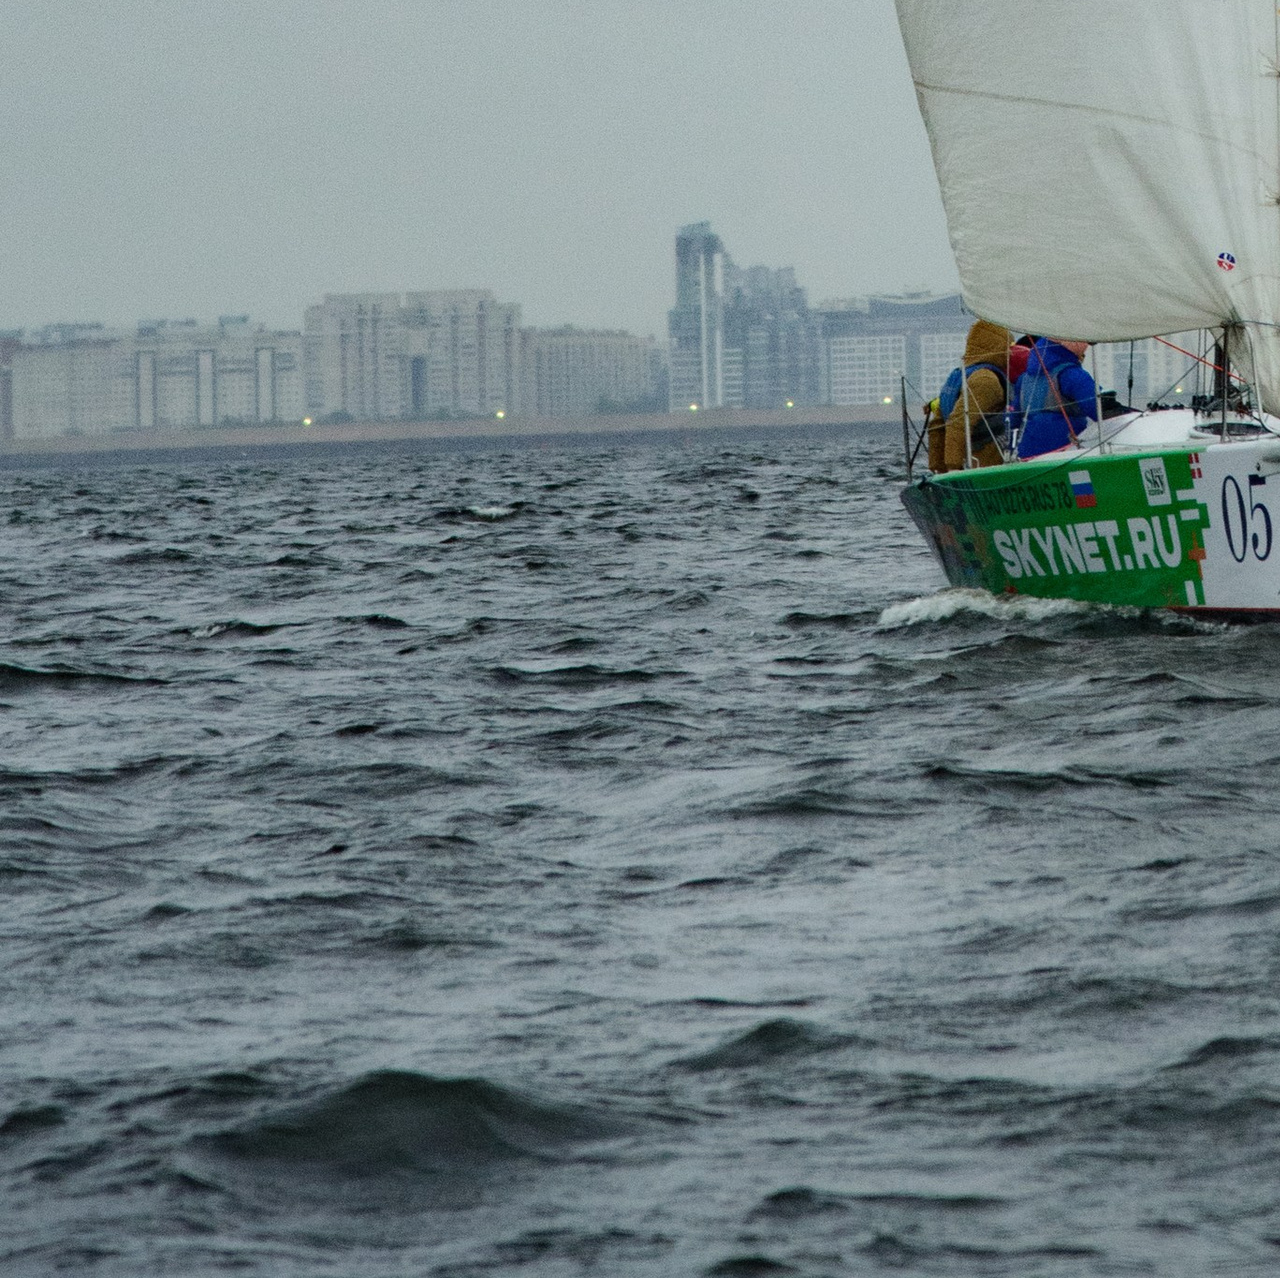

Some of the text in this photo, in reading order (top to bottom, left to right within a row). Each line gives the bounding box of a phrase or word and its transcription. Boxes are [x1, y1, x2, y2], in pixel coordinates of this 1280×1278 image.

[1051, 481, 1073, 509] 78
[1222, 475, 1272, 563] 05
[993, 514, 1182, 578] SKYNET.RU
